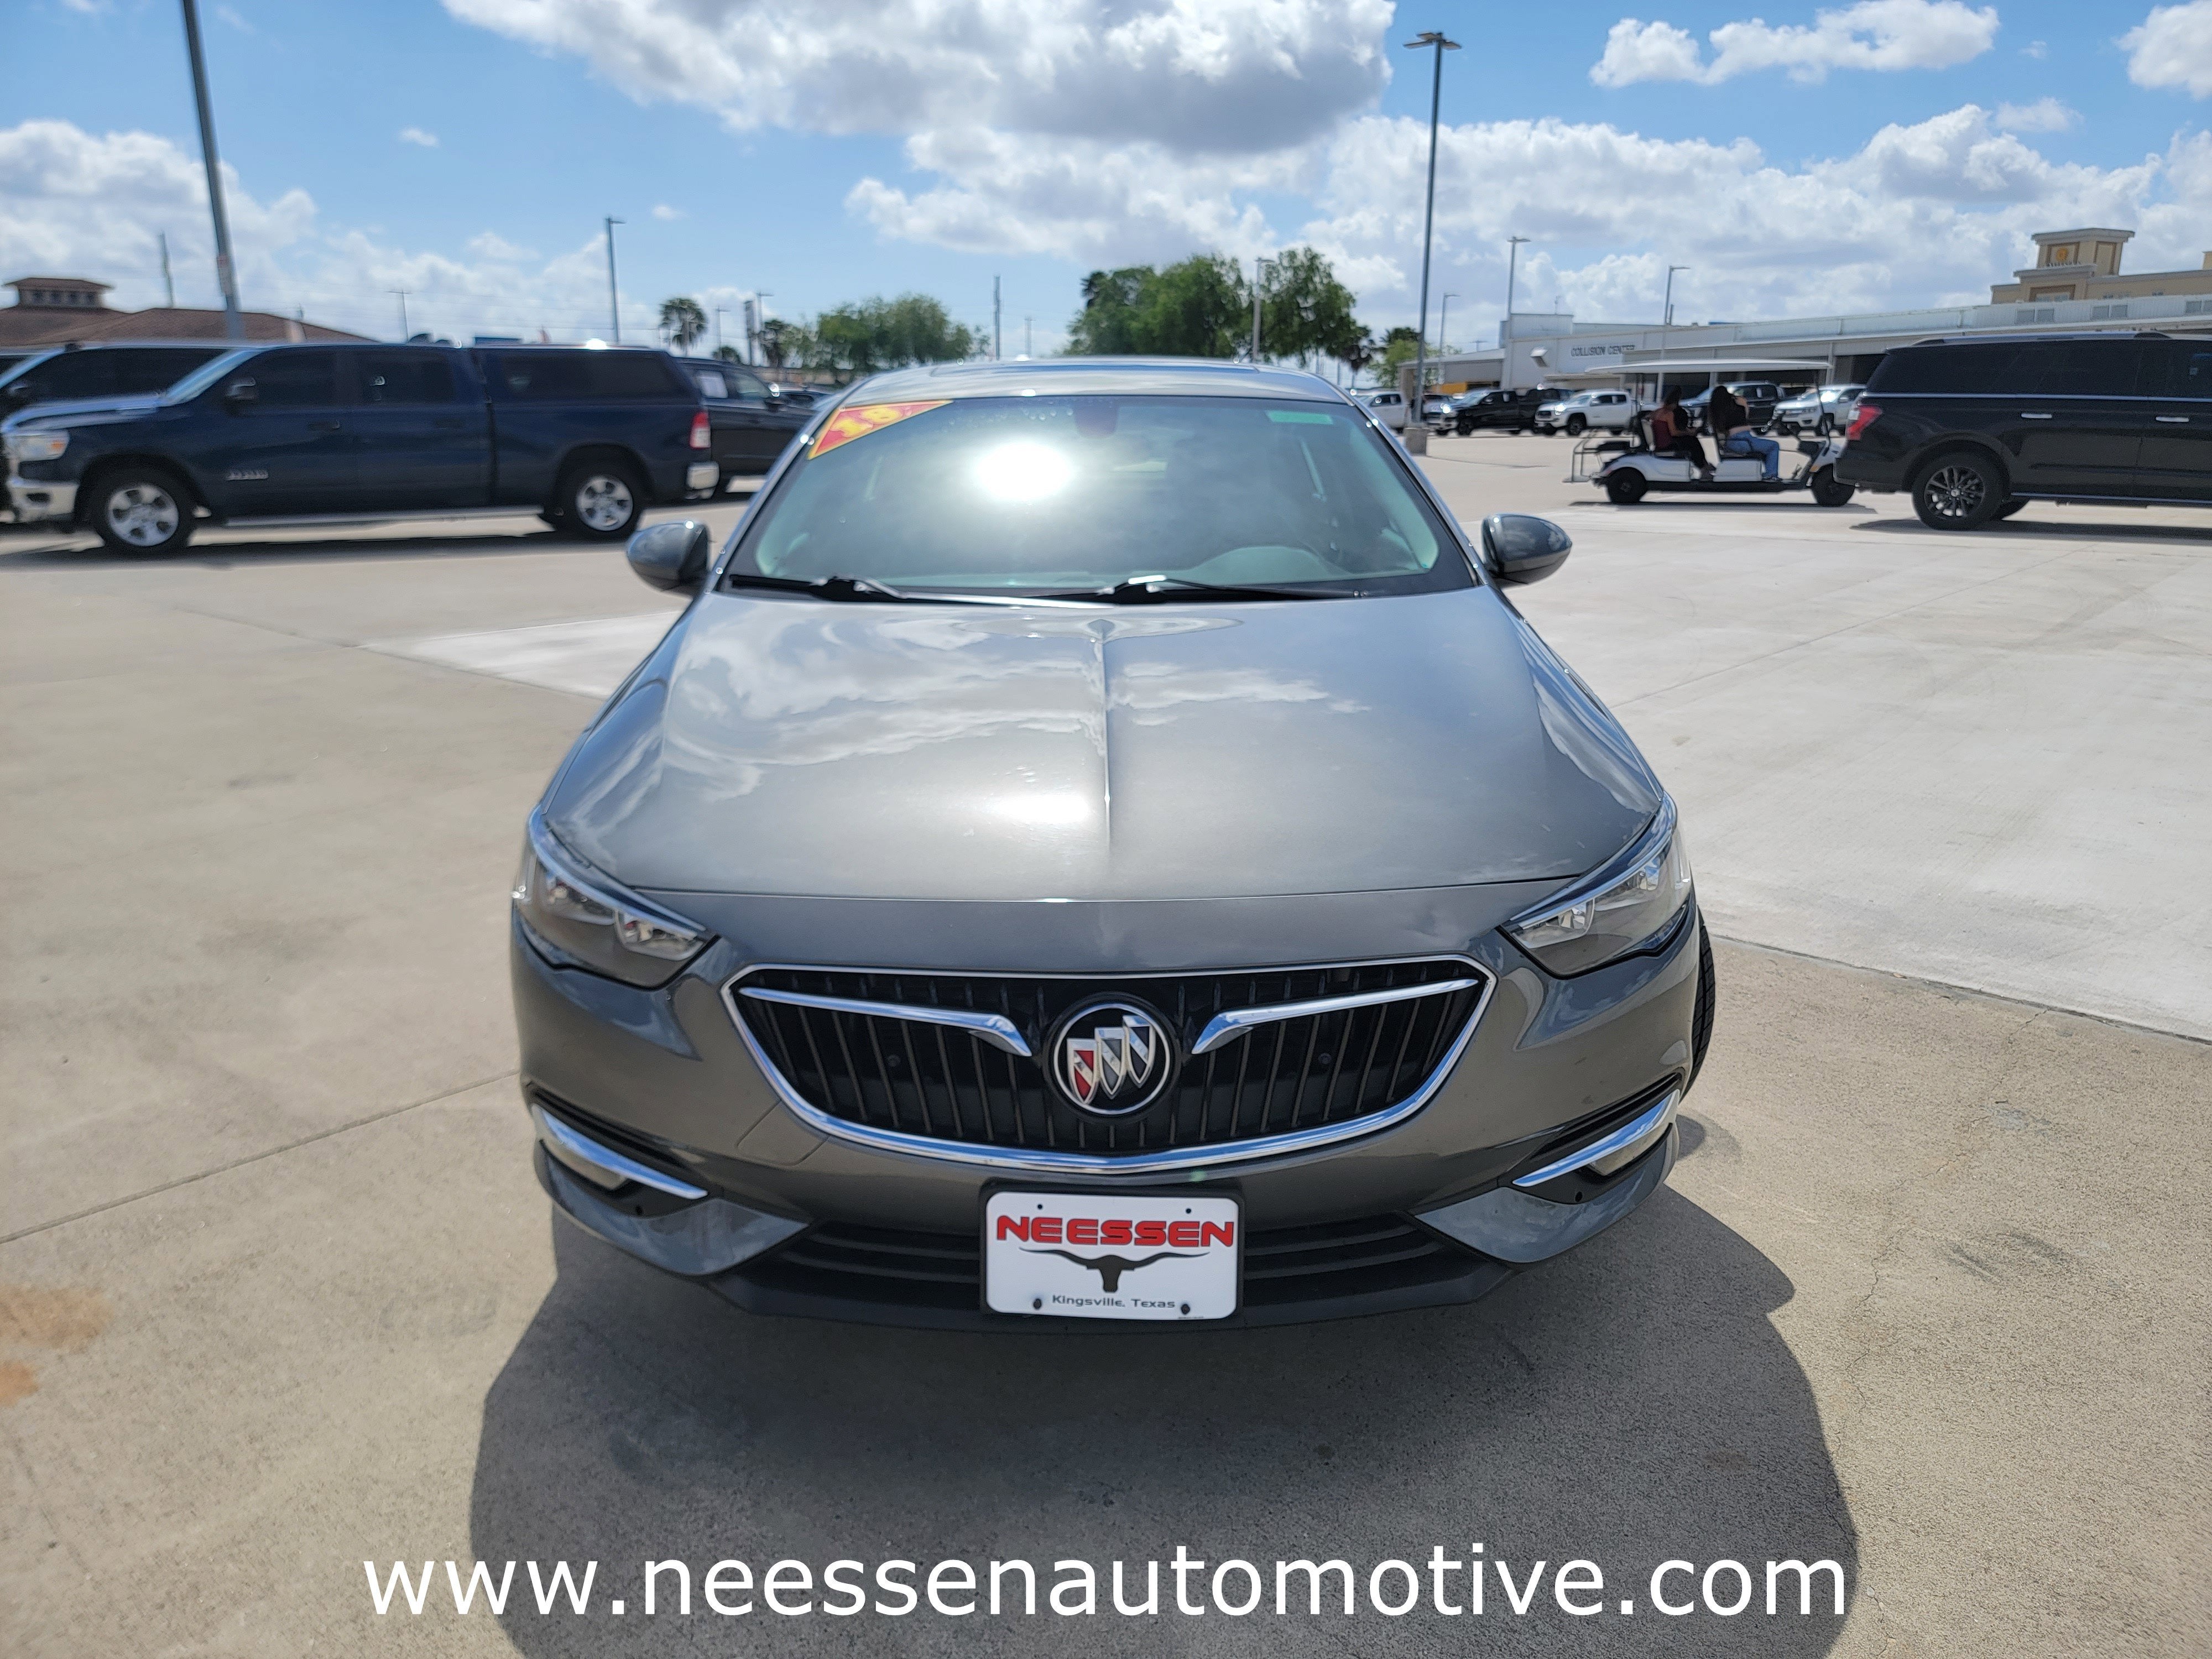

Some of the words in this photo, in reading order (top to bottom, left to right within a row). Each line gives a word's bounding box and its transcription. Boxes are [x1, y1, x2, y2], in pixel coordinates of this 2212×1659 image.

[1571, 346, 1606, 357] COLLISION
[997, 1215, 1234, 1247] NEESSEN
[1052, 1295, 1125, 1307] Kingsville,
[1131, 1298, 1175, 1308] Texas
